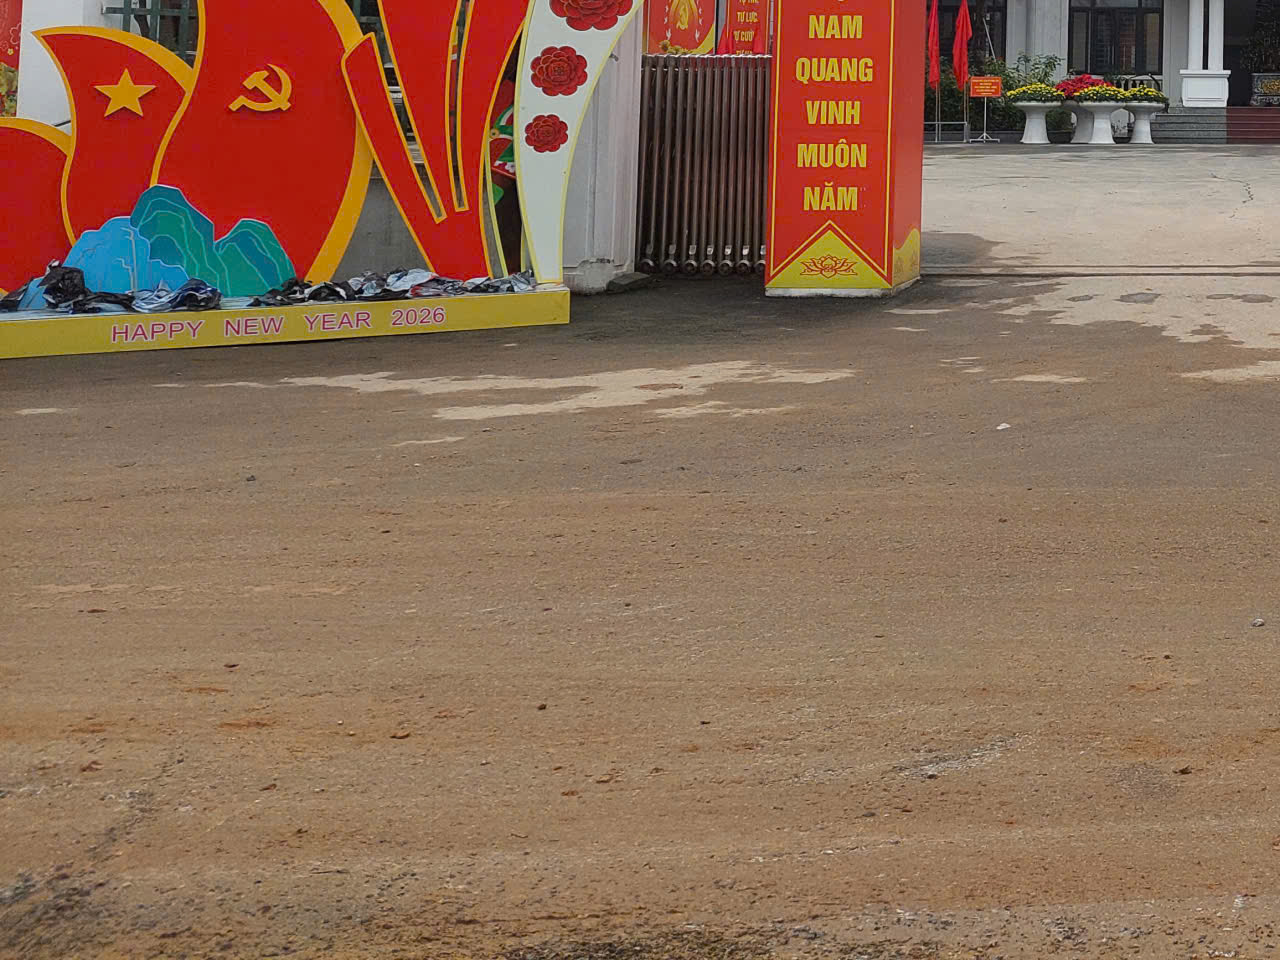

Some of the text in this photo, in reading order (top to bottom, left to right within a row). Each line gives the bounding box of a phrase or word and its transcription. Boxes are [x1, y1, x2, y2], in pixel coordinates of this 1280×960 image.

[808, 15, 863, 39] NAM
[795, 58, 873, 84] QUANG
[806, 100, 860, 125] VINH
[797, 138, 867, 168] MUÔN
[803, 181, 858, 211] NĂM
[111, 306, 446, 344] HAPPY NEW YEAR 2026
